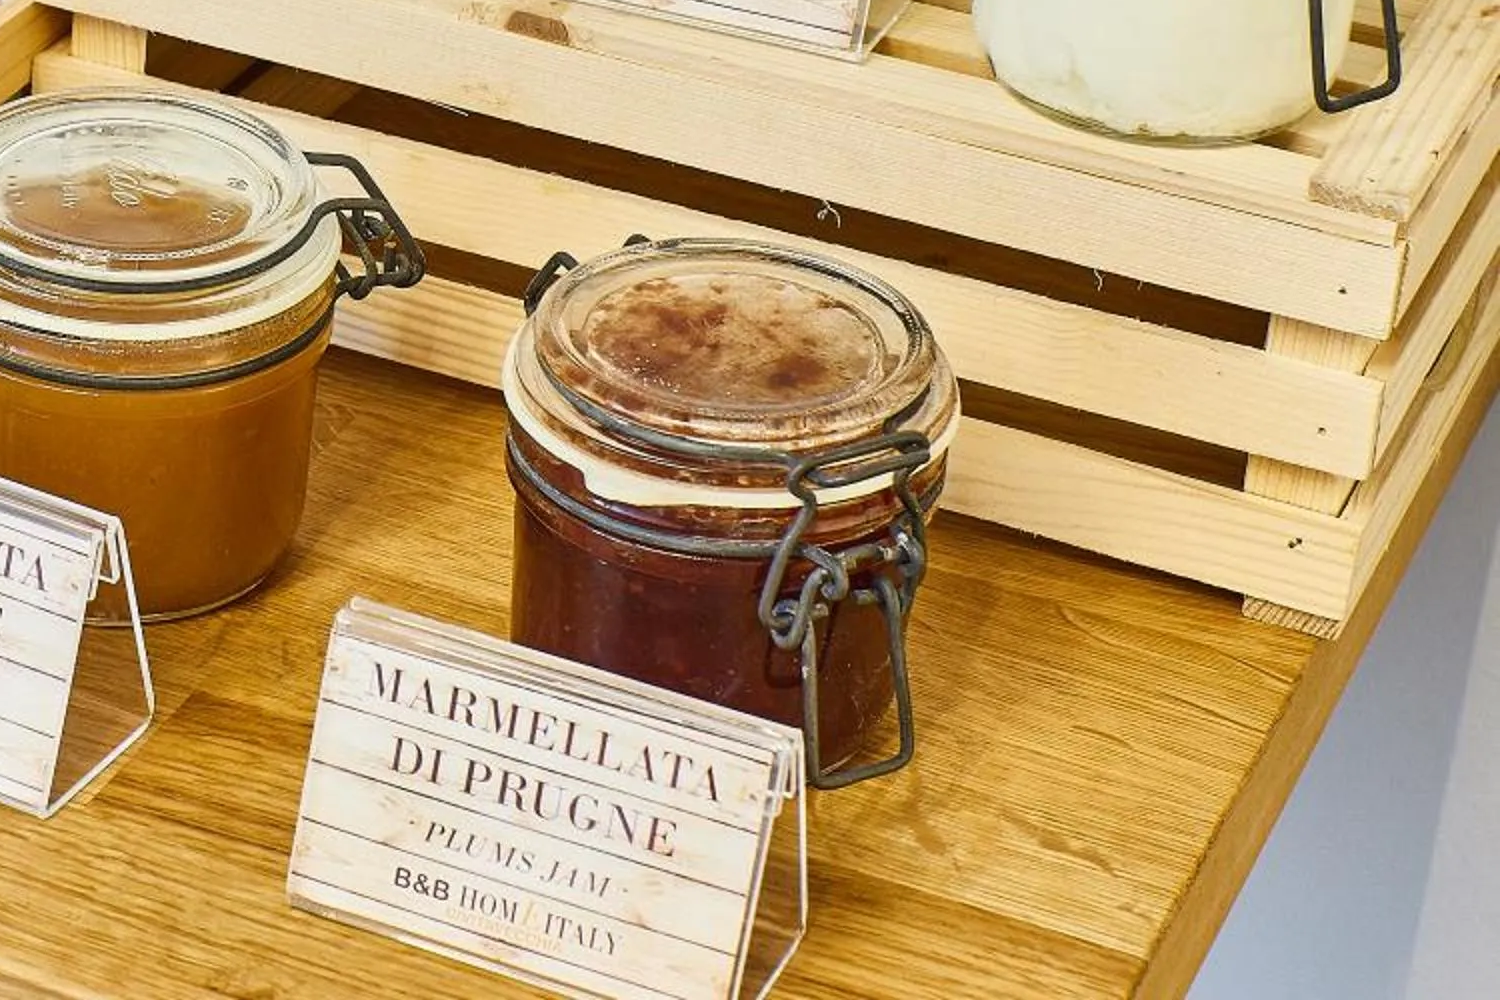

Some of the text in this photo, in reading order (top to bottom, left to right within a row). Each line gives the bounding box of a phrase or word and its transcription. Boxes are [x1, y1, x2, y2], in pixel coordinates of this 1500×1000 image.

[364, 660, 725, 803] MARMELLATA
[387, 734, 679, 860] DI PRUGNE
[393, 866, 451, 902] B&B
[543, 911, 623, 956] ITALY
[423, 820, 613, 899] PLUMS JAM
